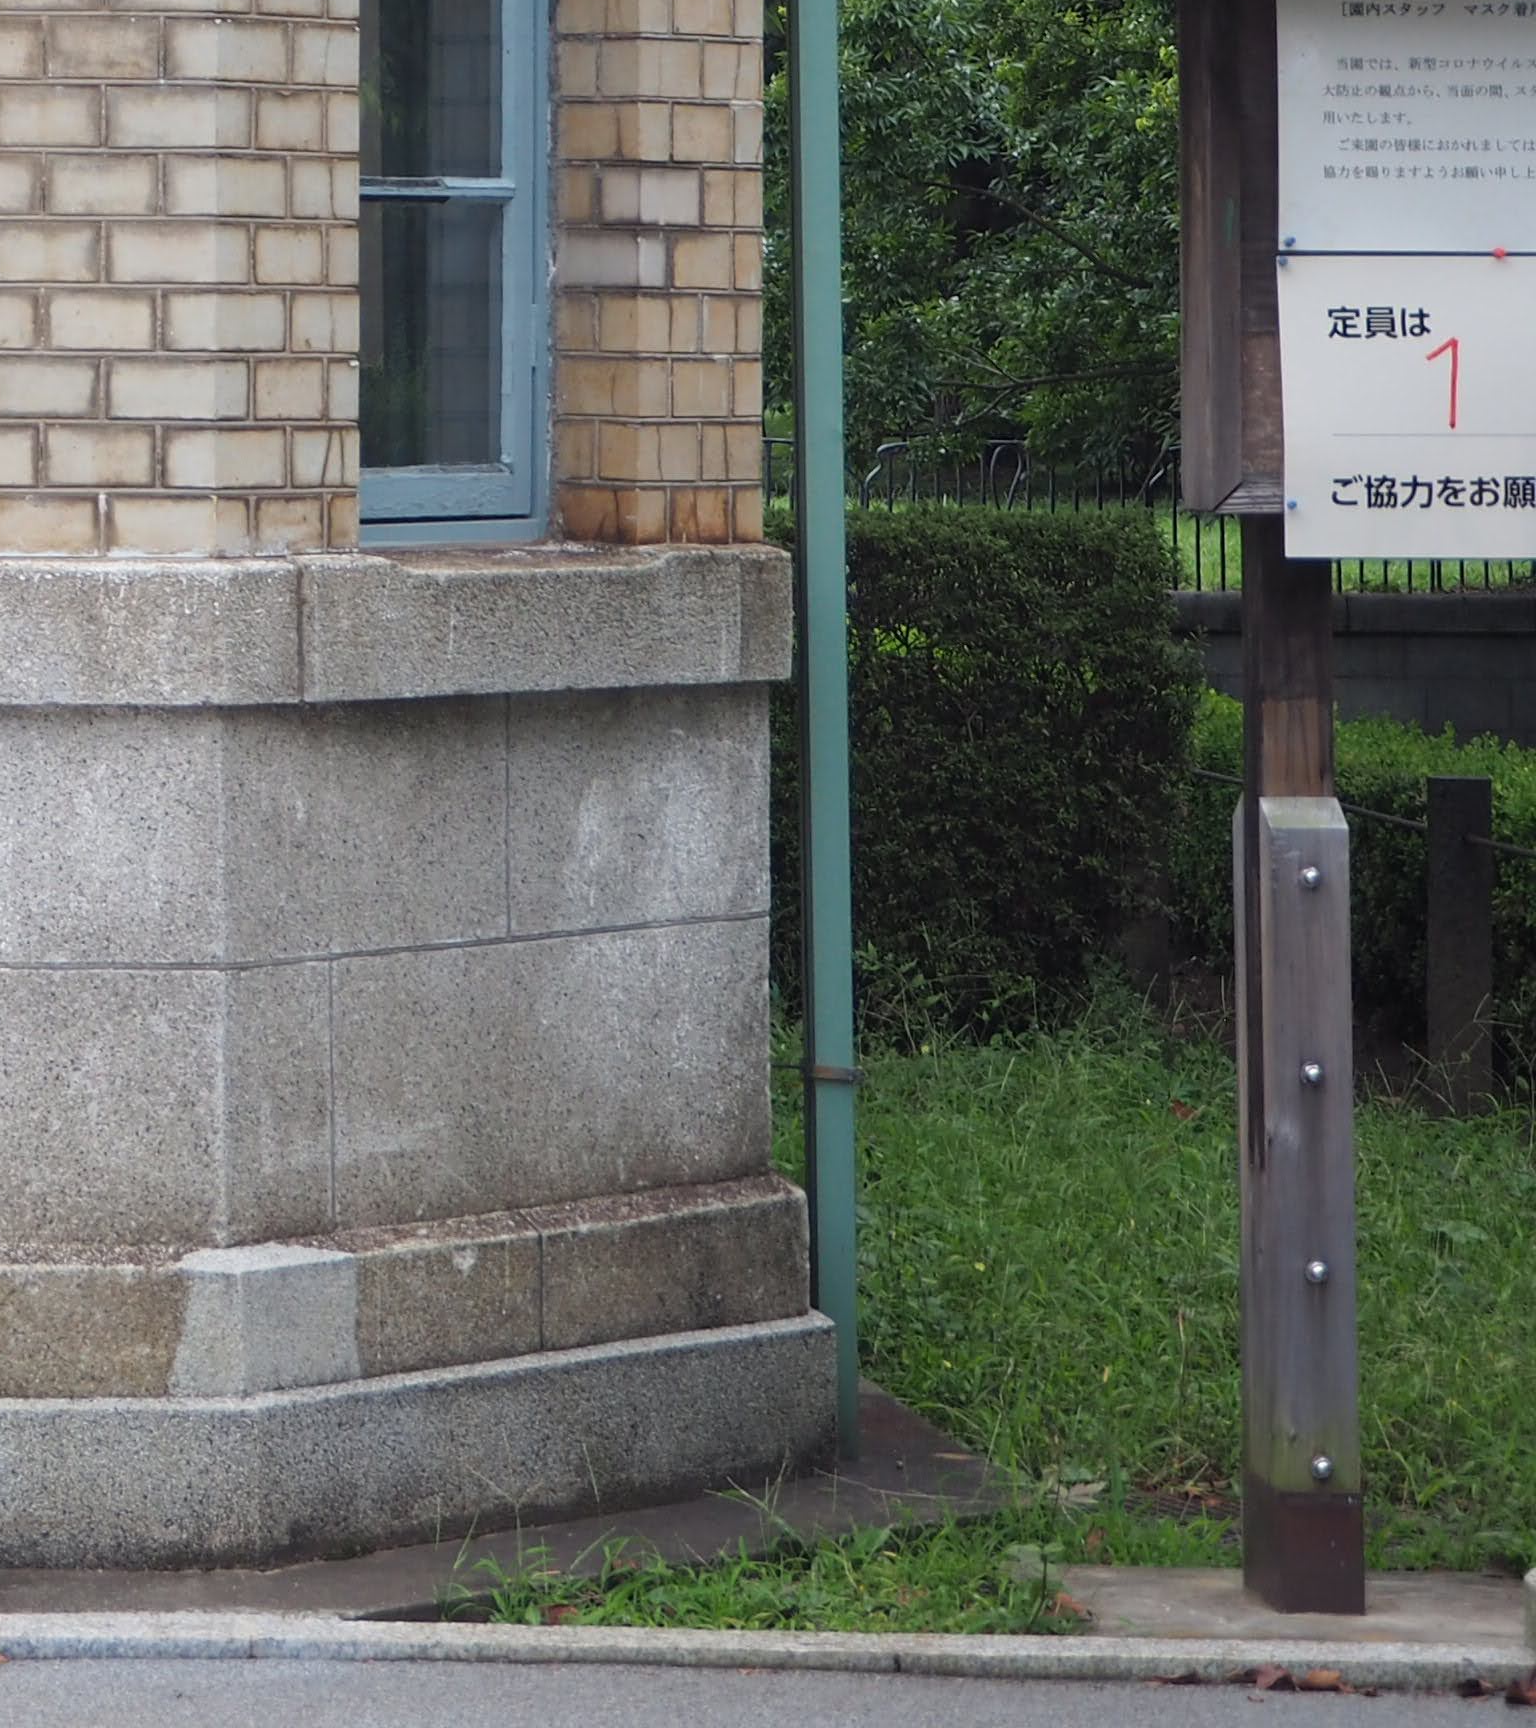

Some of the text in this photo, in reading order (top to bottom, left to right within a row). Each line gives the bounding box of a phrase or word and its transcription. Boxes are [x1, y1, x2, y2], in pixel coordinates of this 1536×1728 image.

[1323, 111, 1413, 126] 用いたします。
[1328, 306, 1431, 339] 定員は
[1426, 337, 1459, 430] 1
[1331, 475, 1536, 509] ご協力をお願
